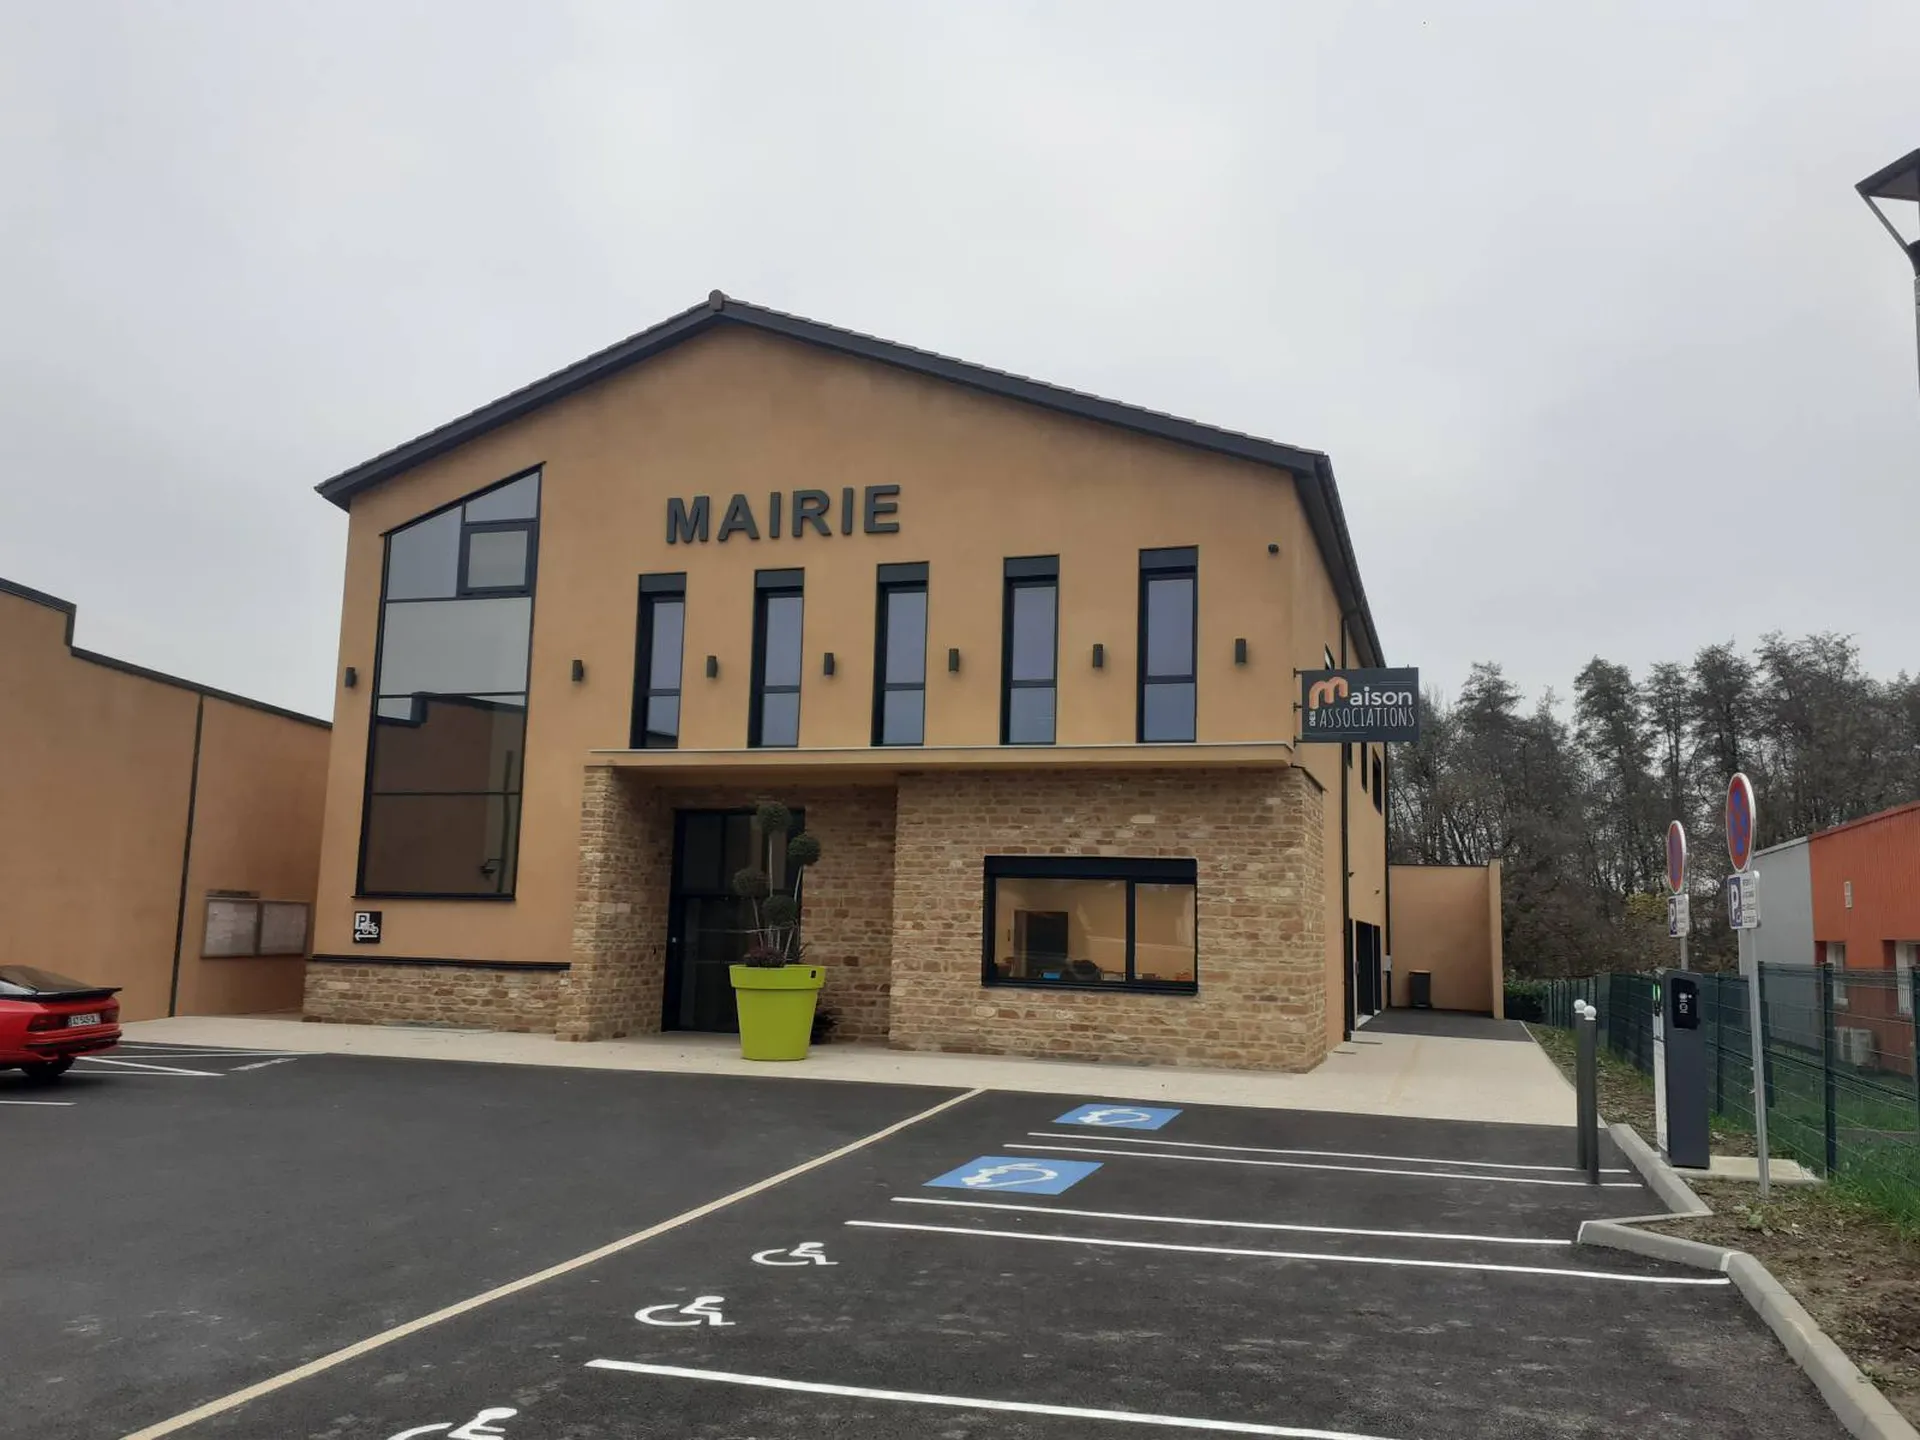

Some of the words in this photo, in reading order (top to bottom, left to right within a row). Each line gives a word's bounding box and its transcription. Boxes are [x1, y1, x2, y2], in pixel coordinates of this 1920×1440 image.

[666, 484, 901, 544] MAIRIE
[1308, 710, 1317, 727] DES
[1319, 706, 1416, 728] ASSOCIATIONS
[358, 915, 367, 928] P
